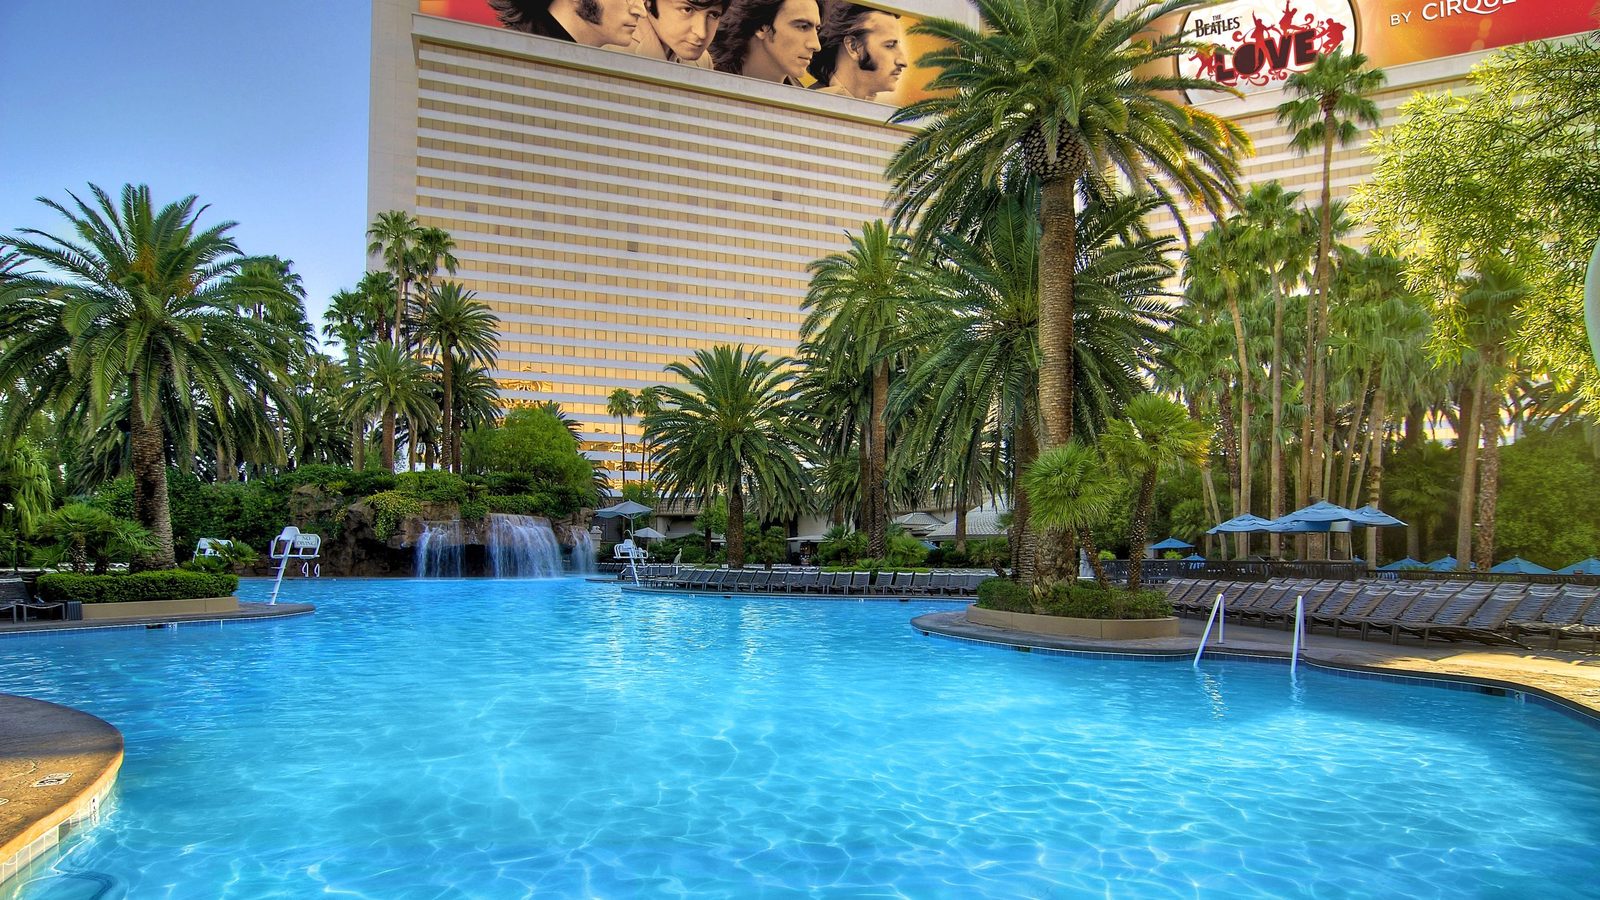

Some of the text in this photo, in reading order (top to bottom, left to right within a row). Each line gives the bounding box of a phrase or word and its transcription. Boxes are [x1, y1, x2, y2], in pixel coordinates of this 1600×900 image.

[1390, 0, 1517, 26] BY CIRQ
[1195, 16, 1241, 38] BEATLES
[1214, 29, 1319, 84] LOVE
